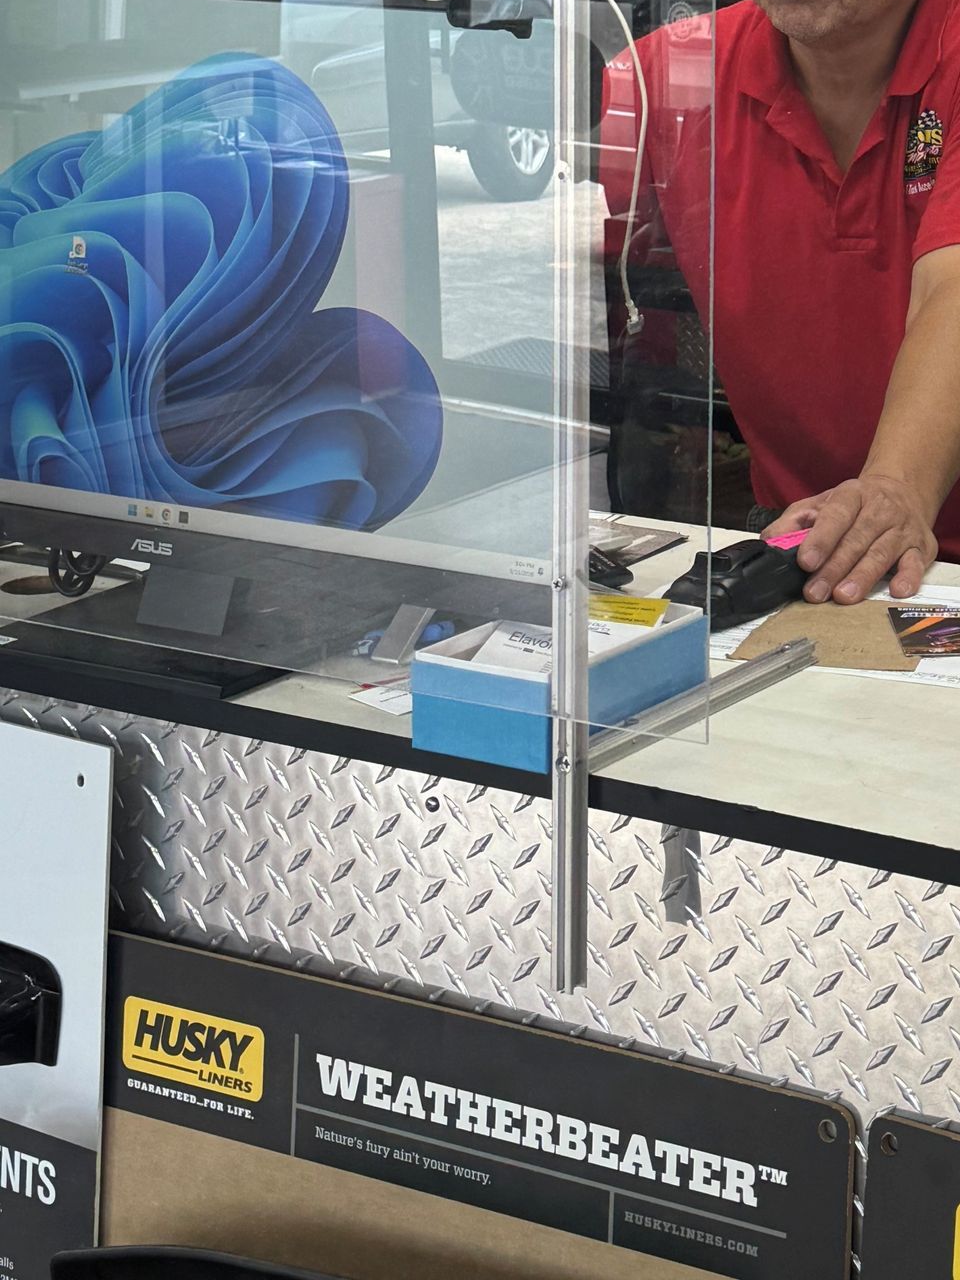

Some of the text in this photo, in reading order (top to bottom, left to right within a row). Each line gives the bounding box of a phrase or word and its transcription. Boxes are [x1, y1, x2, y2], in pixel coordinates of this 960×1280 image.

[131, 538, 173, 556] ASUS
[508, 631, 552, 650] Elavo
[134, 1009, 254, 1072] HUSKY
[198, 1070, 253, 1094] LINERS
[227, 1106, 255, 1120] LIFE.
[314, 1126, 492, 1186] Nature's fury ain't your worry.
[0, 1145, 56, 1206] NTS
[624, 1210, 759, 1258] HUSKYLINERS.COM
